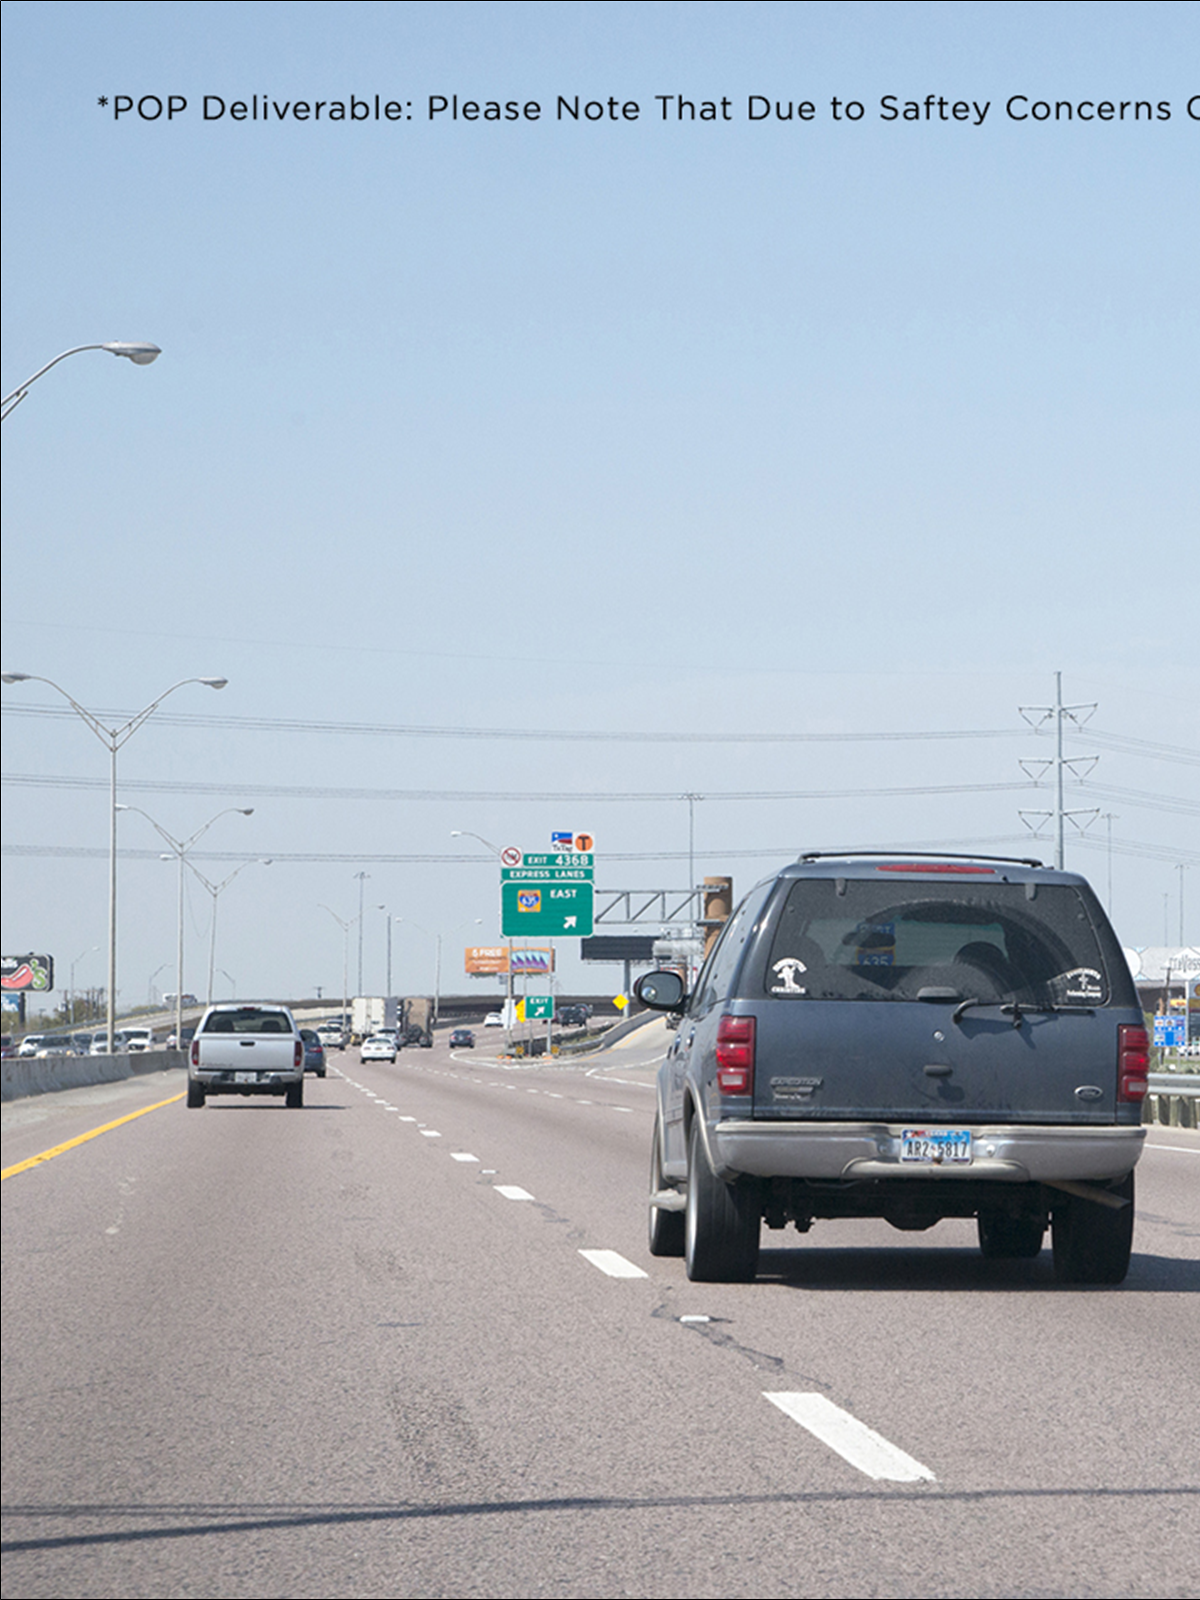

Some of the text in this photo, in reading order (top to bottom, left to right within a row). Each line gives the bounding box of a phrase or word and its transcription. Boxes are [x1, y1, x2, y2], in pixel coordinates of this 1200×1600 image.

[527, 856, 548, 865] EXIT
[509, 870, 585, 879] EXPRESS LANES
[549, 889, 578, 899] EAST
